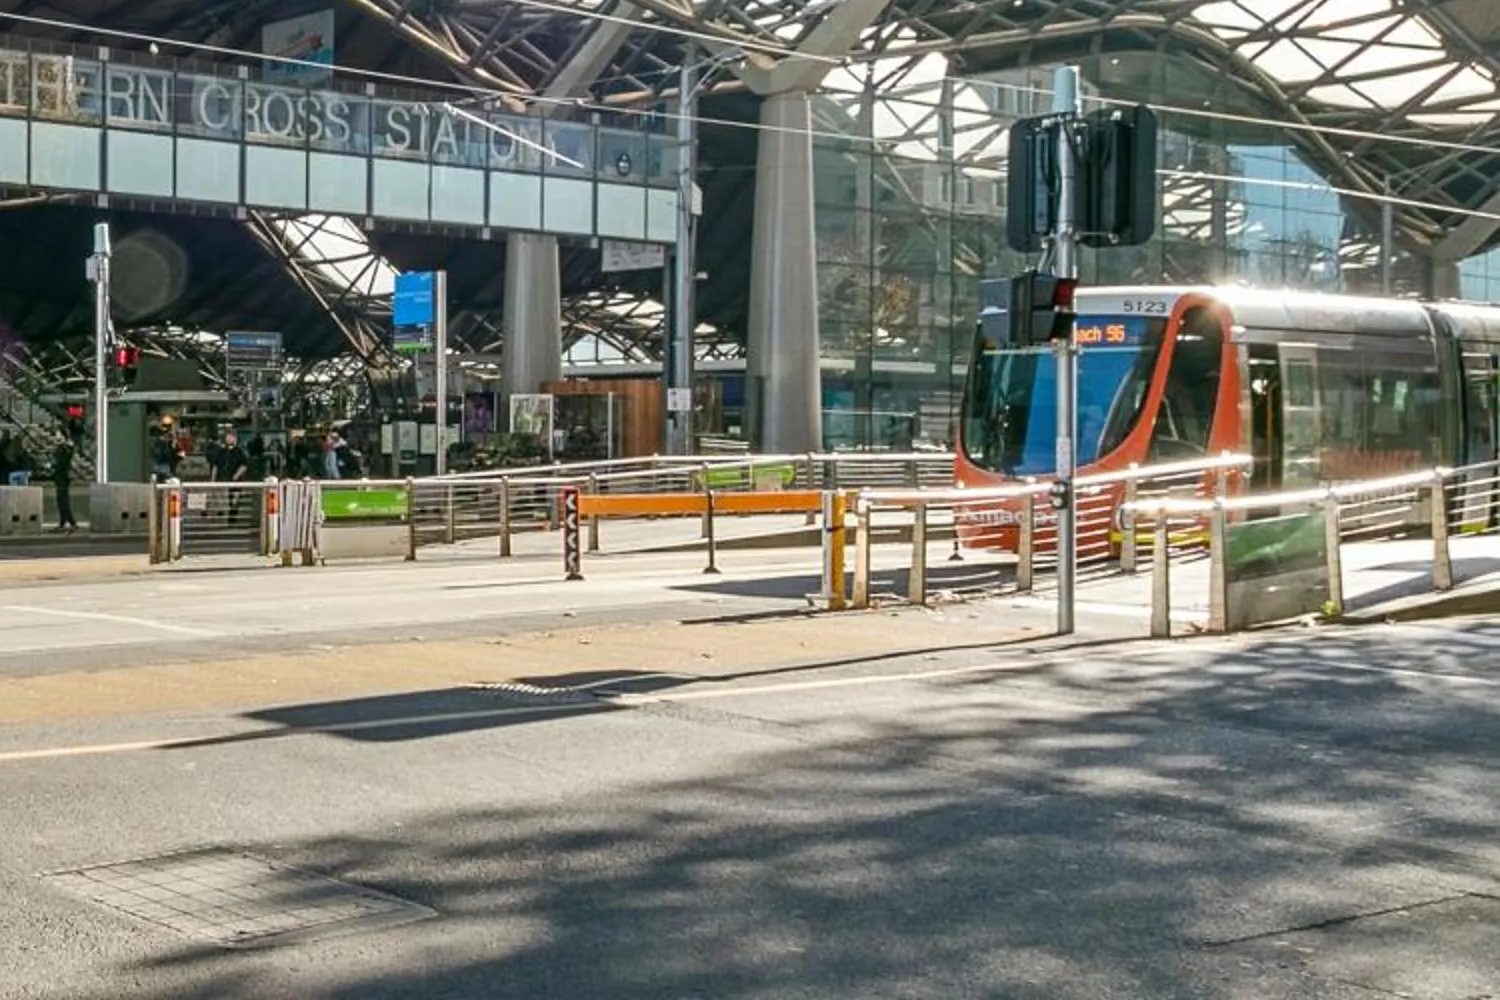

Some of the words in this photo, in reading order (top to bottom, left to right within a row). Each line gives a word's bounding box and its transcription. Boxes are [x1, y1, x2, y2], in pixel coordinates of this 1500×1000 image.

[200, 84, 351, 143] CROSS
[386, 103, 545, 167] STATON
[1123, 300, 1167, 313] 5123
